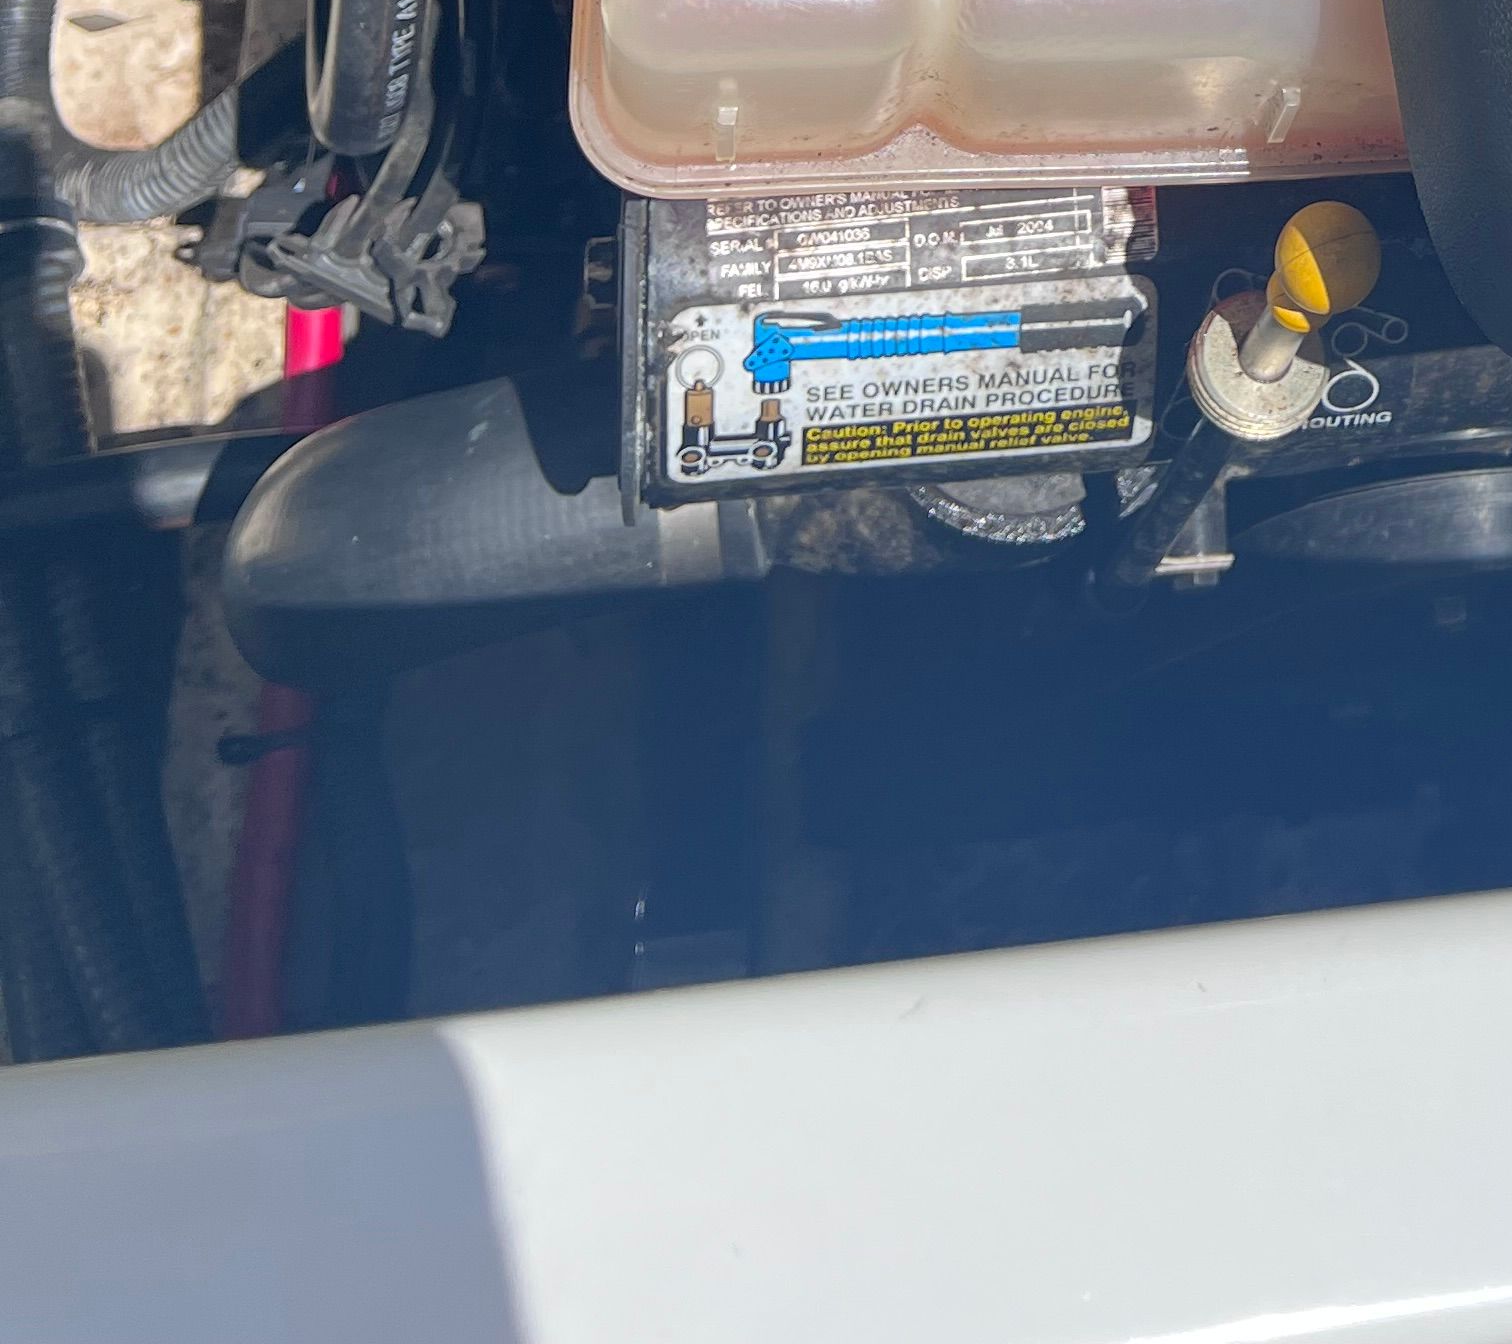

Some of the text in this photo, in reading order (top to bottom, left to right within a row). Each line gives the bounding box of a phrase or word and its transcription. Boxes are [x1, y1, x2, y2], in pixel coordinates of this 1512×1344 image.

[757, 199, 777, 211] TO
[806, 361, 1136, 402] SEE OWNERS MANUAL FOR
[806, 382, 1134, 421] WATER DRAIN PROCEDURE
[807, 410, 1056, 441] Caution: Prior to operating
[807, 416, 1129, 453] assure that drain valves are closed
[834, 436, 1037, 462] opening manual relief
